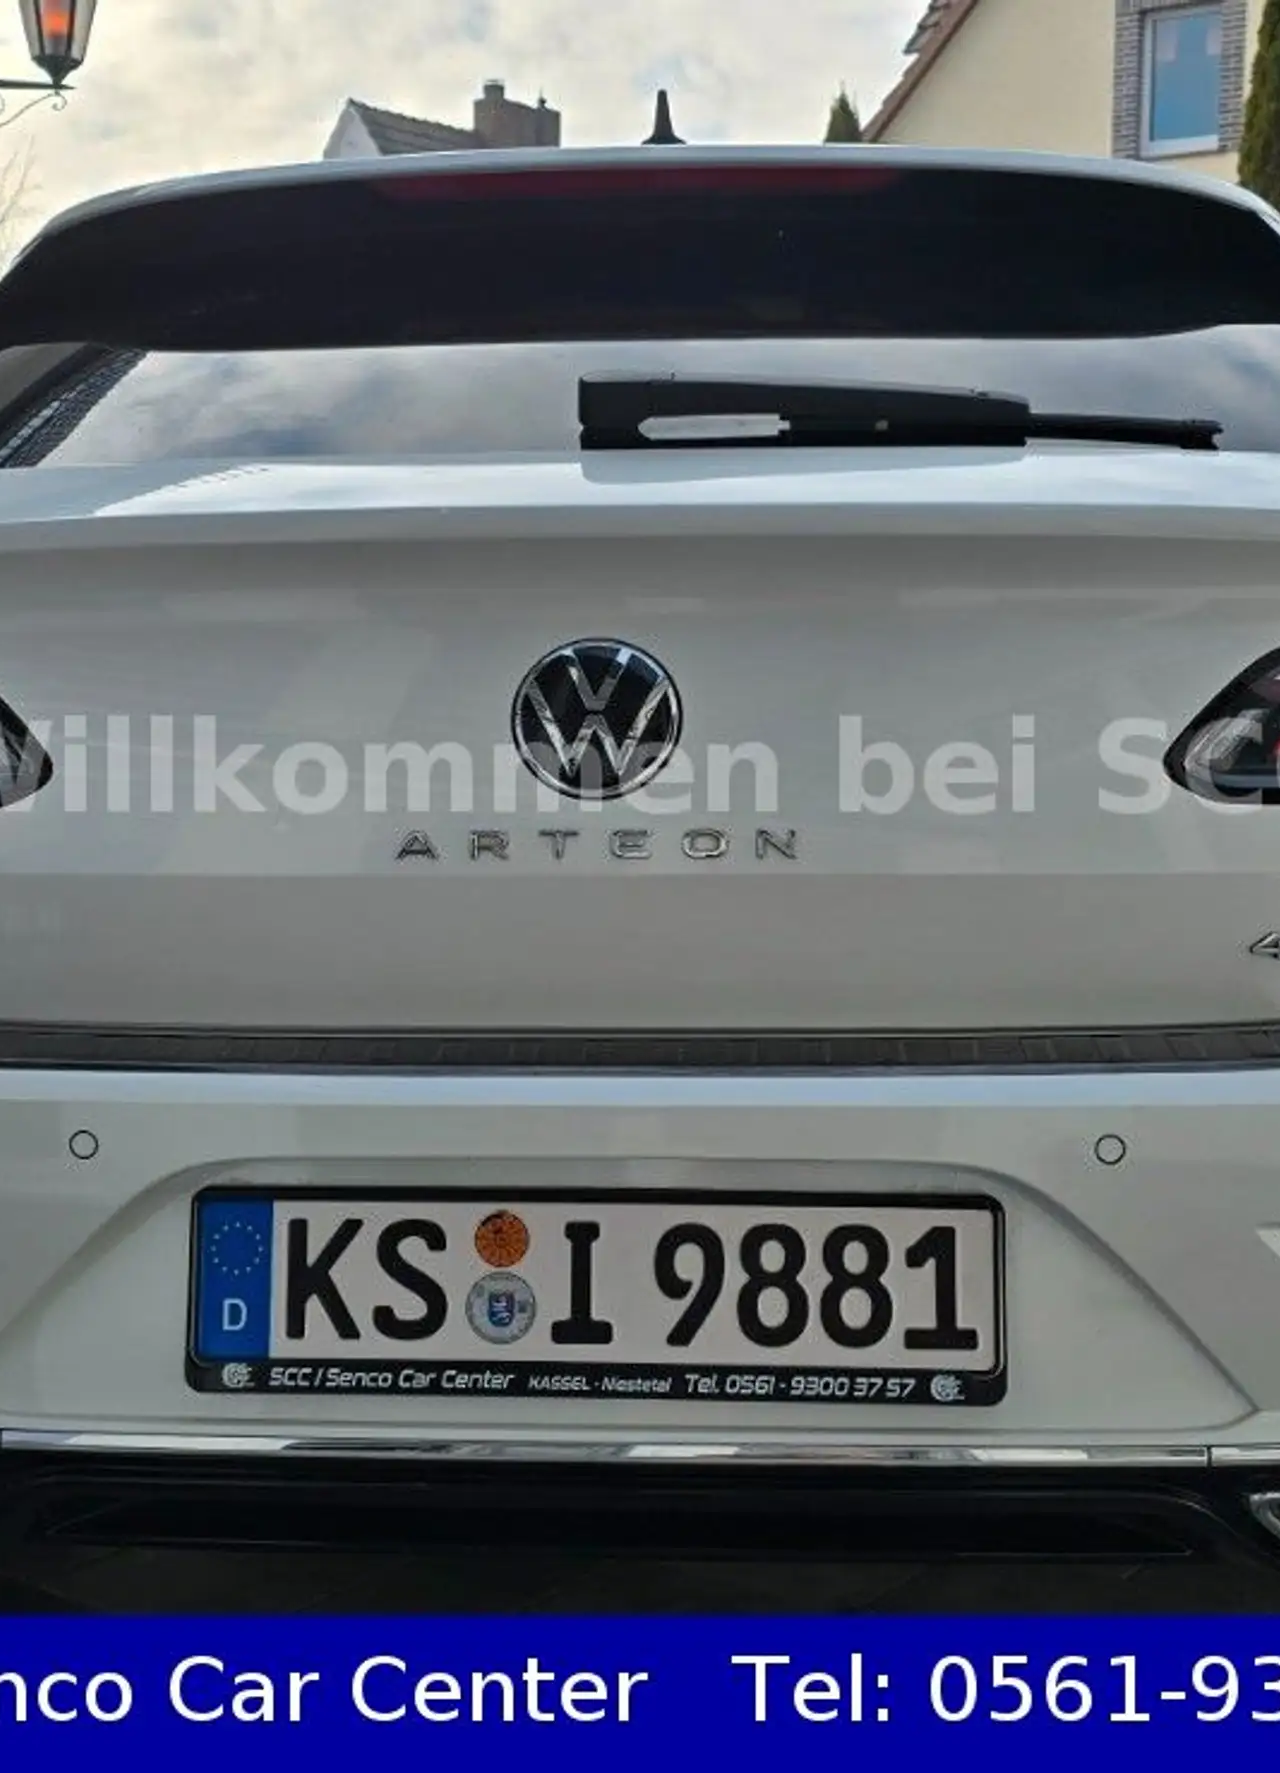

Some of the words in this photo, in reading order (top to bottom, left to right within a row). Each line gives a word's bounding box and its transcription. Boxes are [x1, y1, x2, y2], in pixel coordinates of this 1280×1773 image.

[395, 828, 800, 861] ARTEON
[286, 1217, 449, 1341] KS
[551, 1221, 614, 1345] I
[654, 1222, 980, 1350] 9881
[222, 1298, 248, 1331] D
[269, 1367, 313, 1387] SCC
[324, 1369, 393, 1388] Senco
[397, 1370, 437, 1388] Car
[440, 1370, 516, 1390] Center
[528, 1375, 591, 1391] KASSEL
